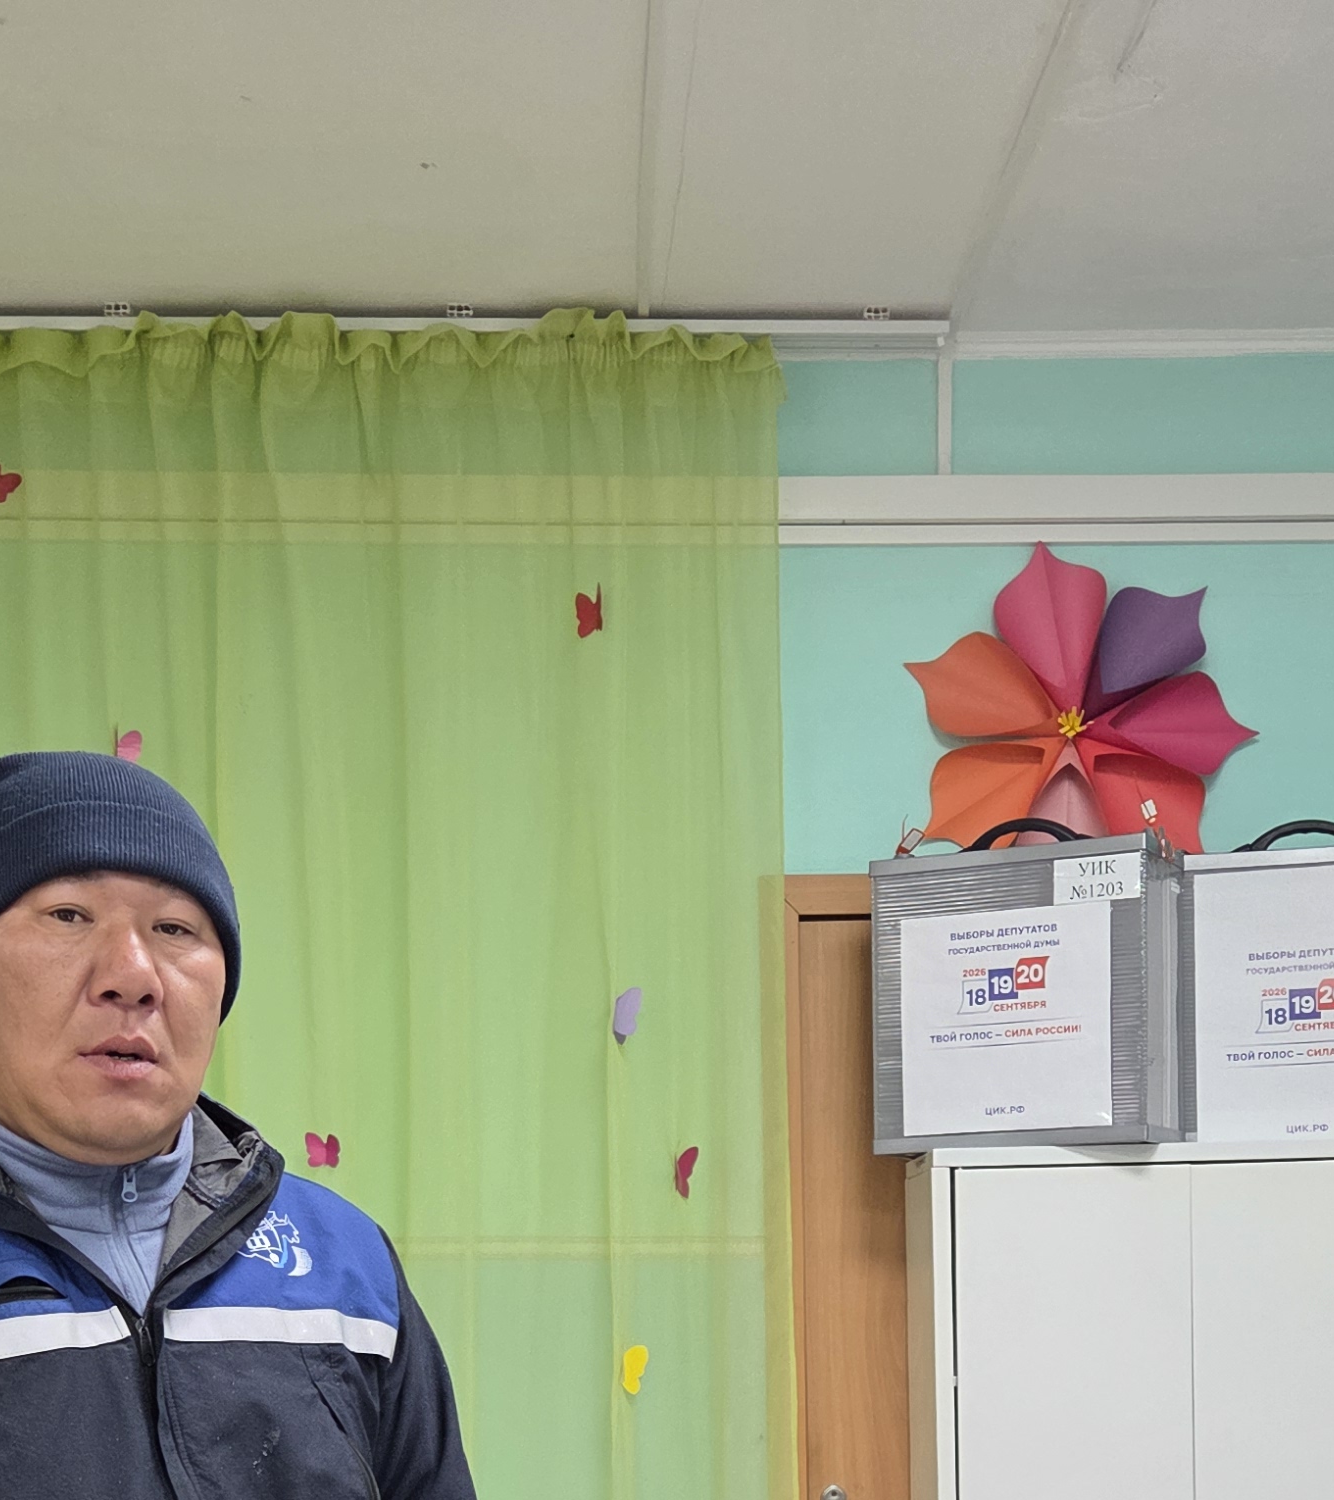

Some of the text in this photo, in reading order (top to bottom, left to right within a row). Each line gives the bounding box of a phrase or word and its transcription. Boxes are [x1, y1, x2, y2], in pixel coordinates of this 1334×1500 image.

[1078, 860, 1117, 877] УИК
[1069, 881, 1124, 900] №1203
[949, 923, 1058, 941] ВЫБОРЫ ДЕПУТАТОВ
[948, 938, 1060, 956] ГОСУДАРСТВЕННОЙ ДУМЫ
[1248, 950, 1296, 962] ВЫБОРЫ
[962, 968, 987, 978] 2026
[966, 964, 1043, 1007] 18 19 20
[1261, 987, 1287, 997] 2026
[993, 1000, 1047, 1012] СЕНТЯБРЯ
[1265, 1007, 1288, 1026] 18
[1291, 995, 1315, 1015] 19
[930, 1031, 957, 1044] ТВОЙ
[959, 1031, 993, 1042] ГОЛОС
[1004, 1027, 1033, 1038] СИЛА
[1035, 1024, 1082, 1037] РОССИИ!
[1226, 1049, 1256, 1062] ТВОЙ
[1257, 1049, 1294, 1060] ГОЛОС
[985, 1105, 1025, 1117] ЦИК.РФ
[1286, 1123, 1329, 1135] ЦИК.РФ
